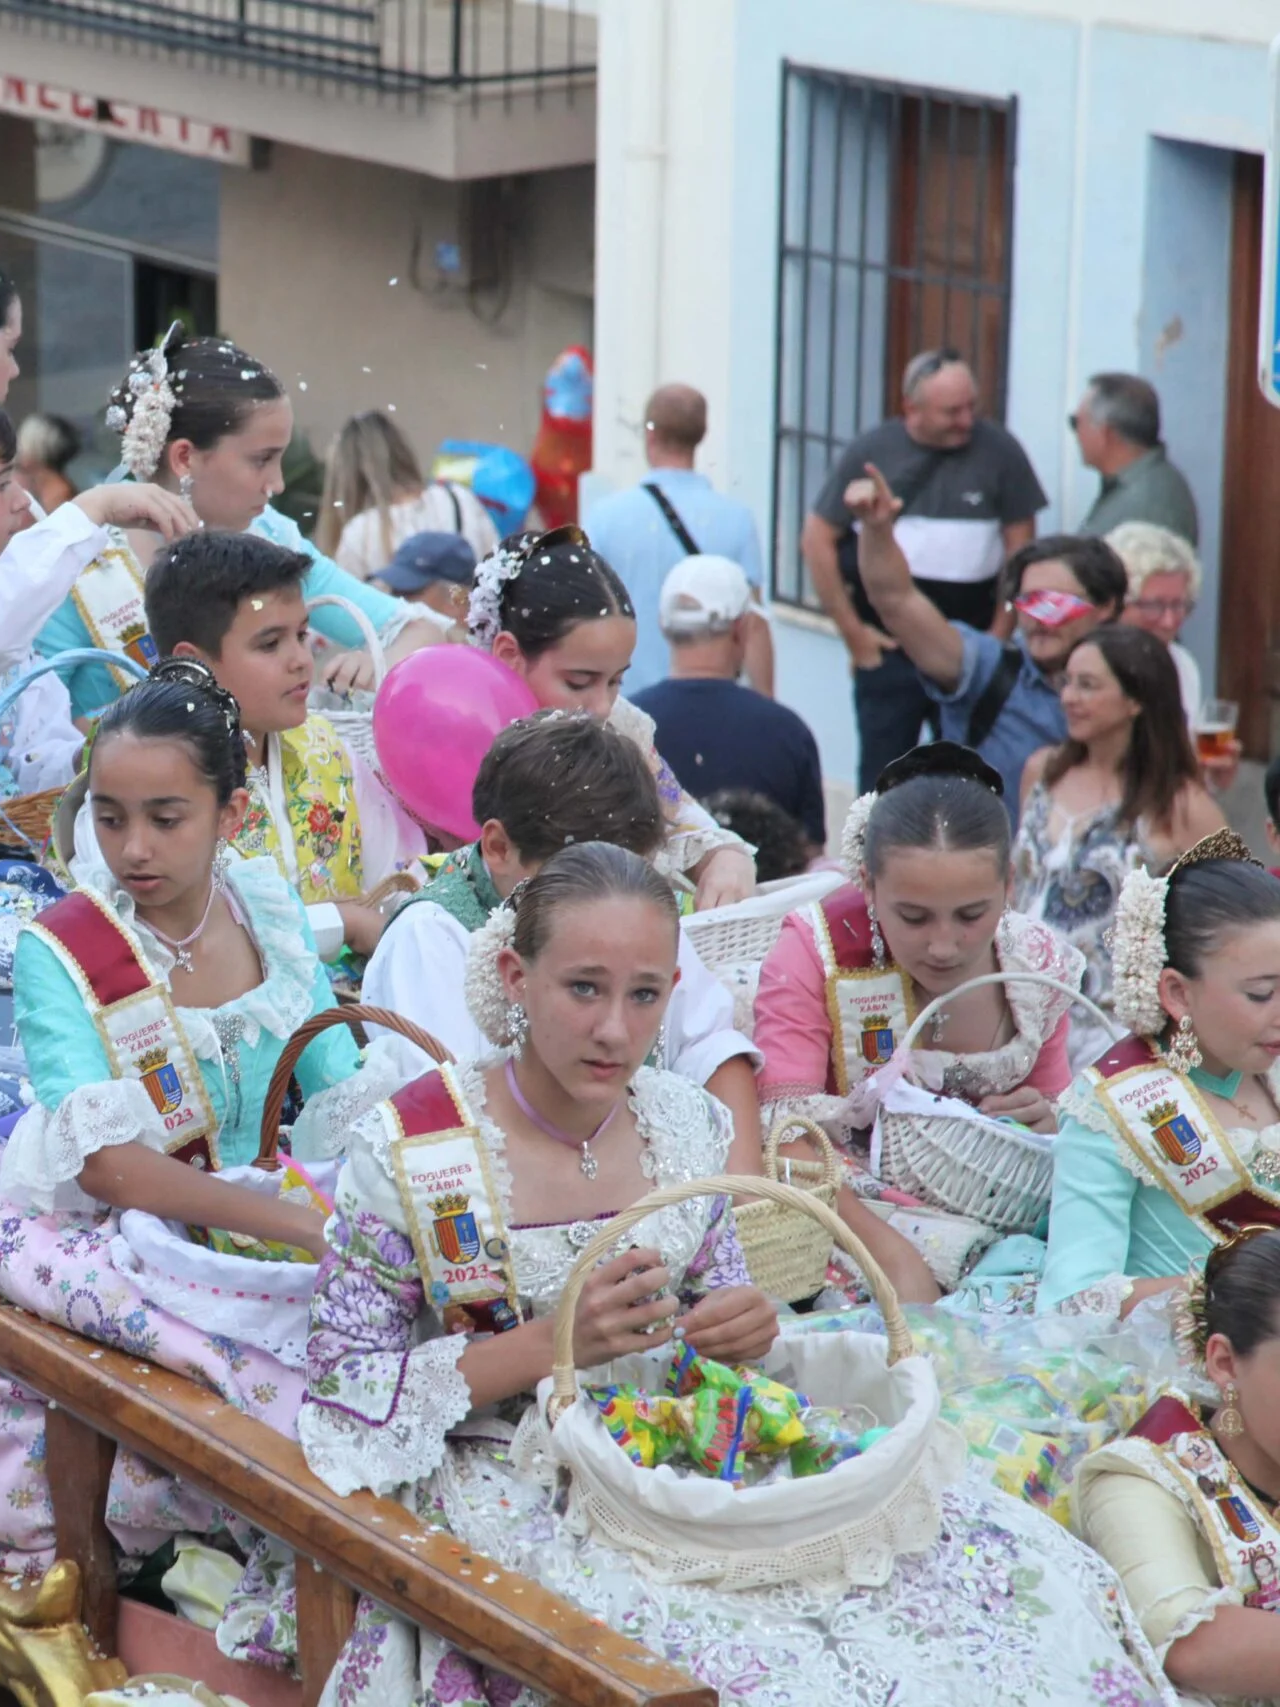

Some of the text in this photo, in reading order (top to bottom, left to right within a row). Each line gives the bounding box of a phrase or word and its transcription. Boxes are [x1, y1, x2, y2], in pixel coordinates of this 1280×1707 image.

[849, 992, 896, 1005] FOGUERES
[115, 1019, 167, 1047] FOGUERES
[1118, 1075, 1173, 1105] FOGUERES
[163, 1107, 194, 1131] 023
[411, 1163, 472, 1185] FOGUERES
[1179, 1156, 1218, 1186] 2023
[442, 1264, 489, 1284] 2023
